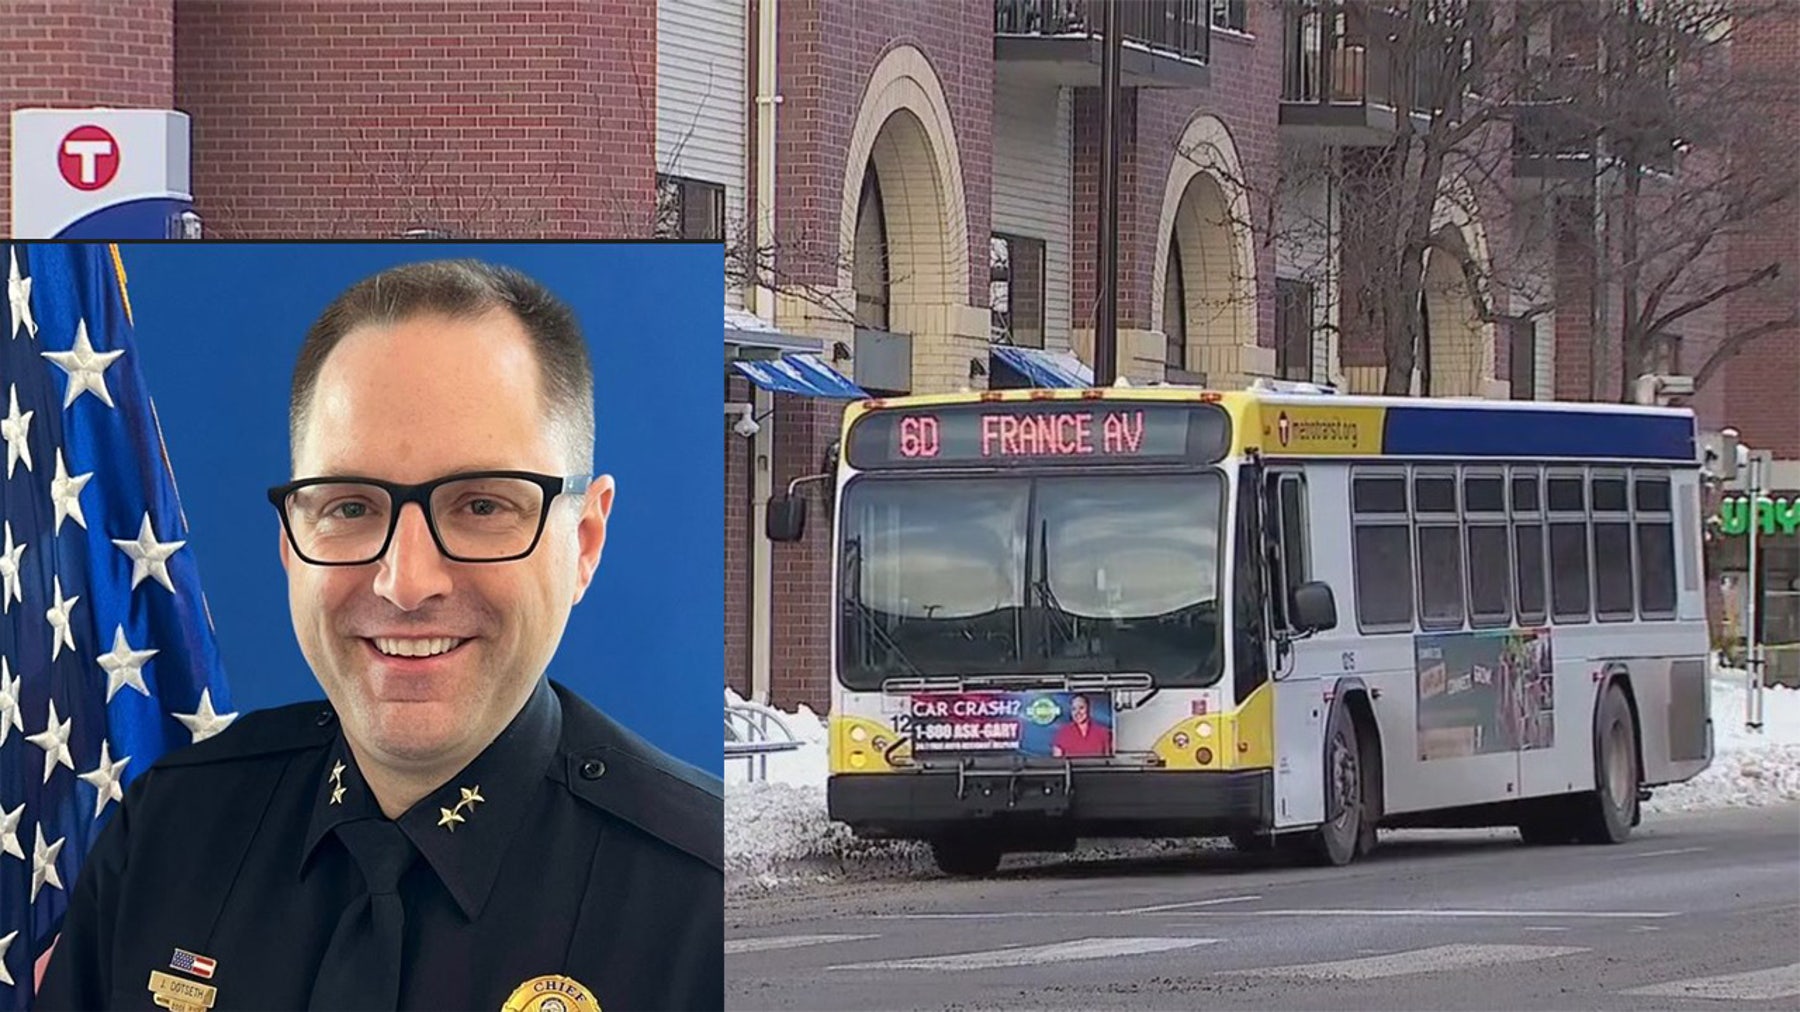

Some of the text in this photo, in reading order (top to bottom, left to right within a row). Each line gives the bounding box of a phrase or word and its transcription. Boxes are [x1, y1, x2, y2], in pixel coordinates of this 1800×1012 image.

[65, 140, 112, 183] T
[900, 411, 1145, 456] 6D FRANCE AV
[913, 701, 948, 717] CAR
[953, 700, 1021, 716] CRASH?
[915, 722, 1019, 739] 1-800 ASK-GARY
[170, 981, 204, 999] DOTSETH
[533, 980, 587, 1003] CHIEF
